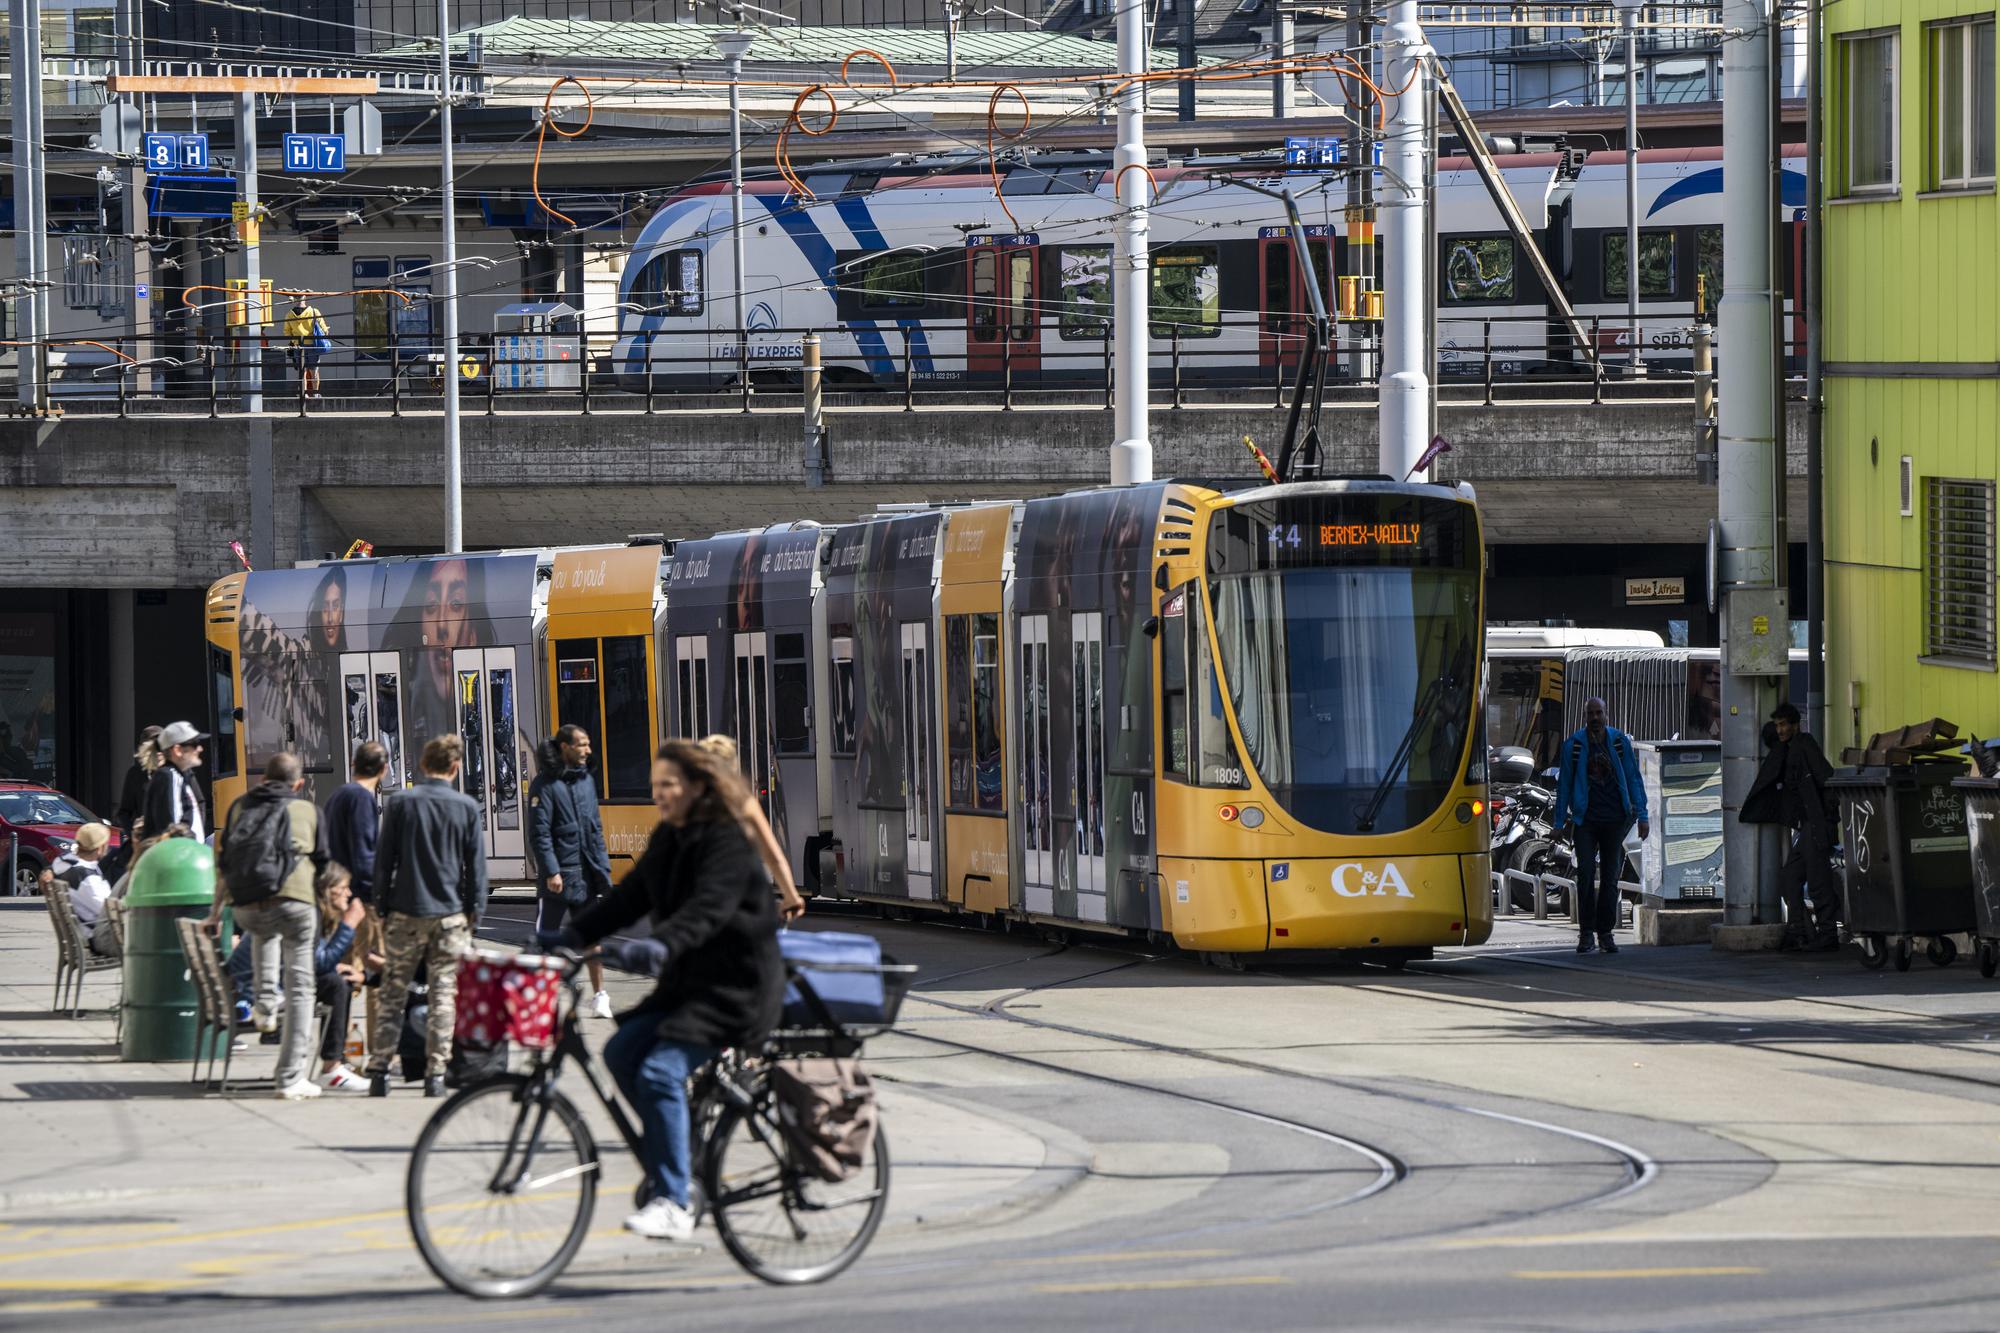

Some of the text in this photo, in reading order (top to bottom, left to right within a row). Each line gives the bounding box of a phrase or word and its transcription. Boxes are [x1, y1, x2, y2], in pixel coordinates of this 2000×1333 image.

[156, 145, 200, 165] 8 H
[294, 146, 336, 166] H 7
[1025, 235, 1031, 245] 2
[1266, 228, 1271, 237] 2
[973, 236, 978, 246] 2
[1652, 335, 1681, 350] SBB
[715, 343, 805, 358] LÉMN EXPRES
[1320, 523, 1420, 546] BERNEX-VAILLY
[1629, 583, 1680, 595] Inside Africa
[1214, 767, 1240, 785] 1809
[1331, 863, 1415, 898] C&A
